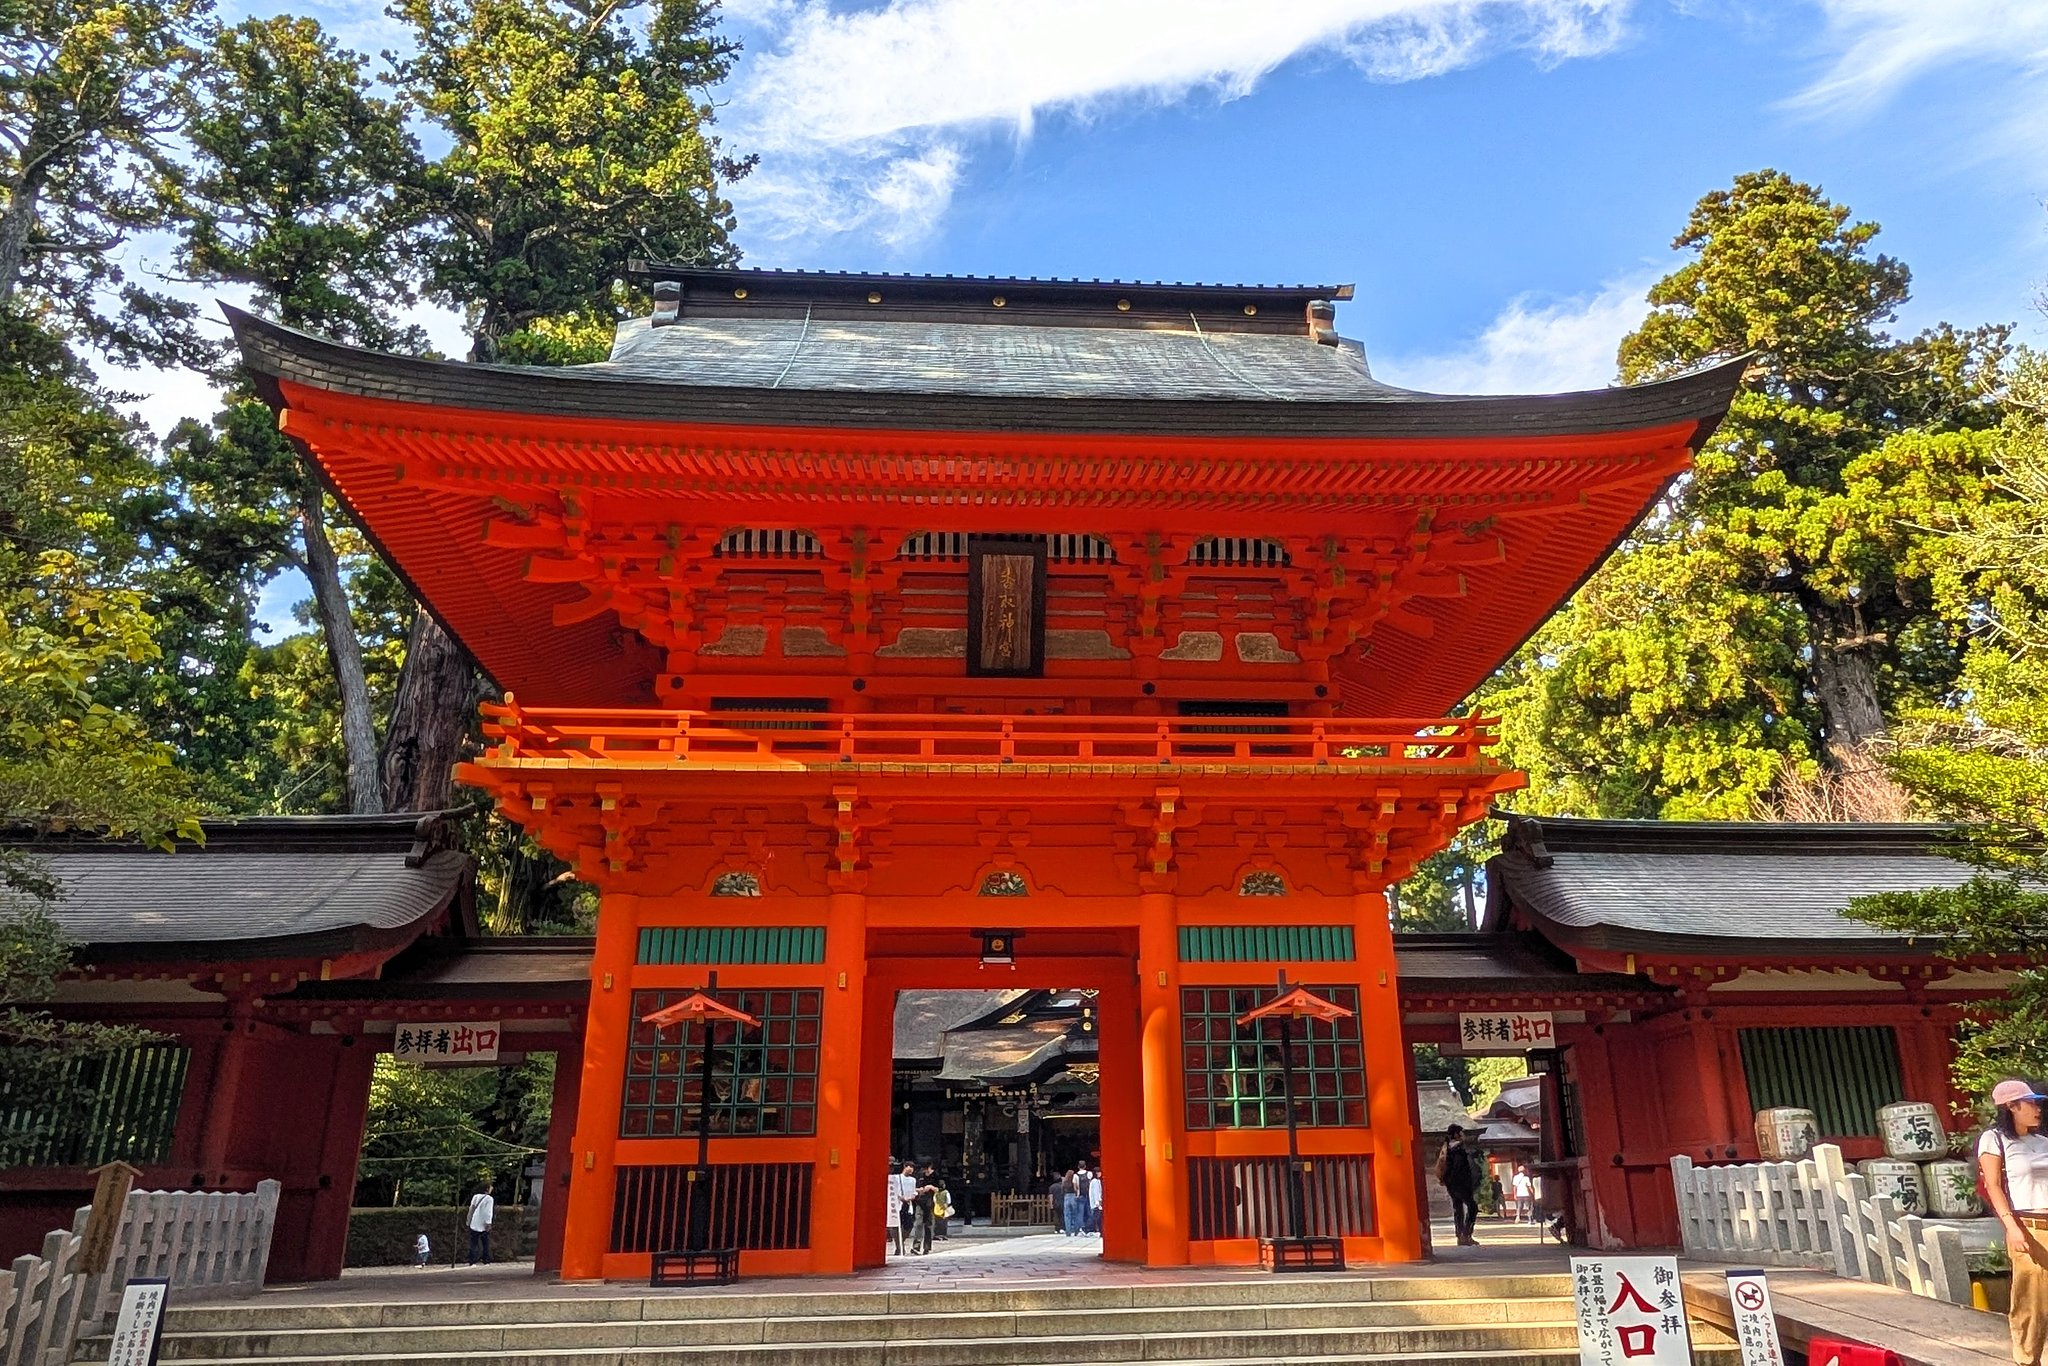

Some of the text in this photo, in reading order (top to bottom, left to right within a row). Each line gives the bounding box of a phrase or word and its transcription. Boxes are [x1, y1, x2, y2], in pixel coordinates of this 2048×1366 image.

[397, 1025, 498, 1055] 参拝者出口
[1463, 1015, 1552, 1043] 参拝者出口
[1576, 1264, 1597, 1342] 御参拝ください。
[1607, 1271, 1661, 1358] 入口
[1653, 1266, 1683, 1335] 御参拝
